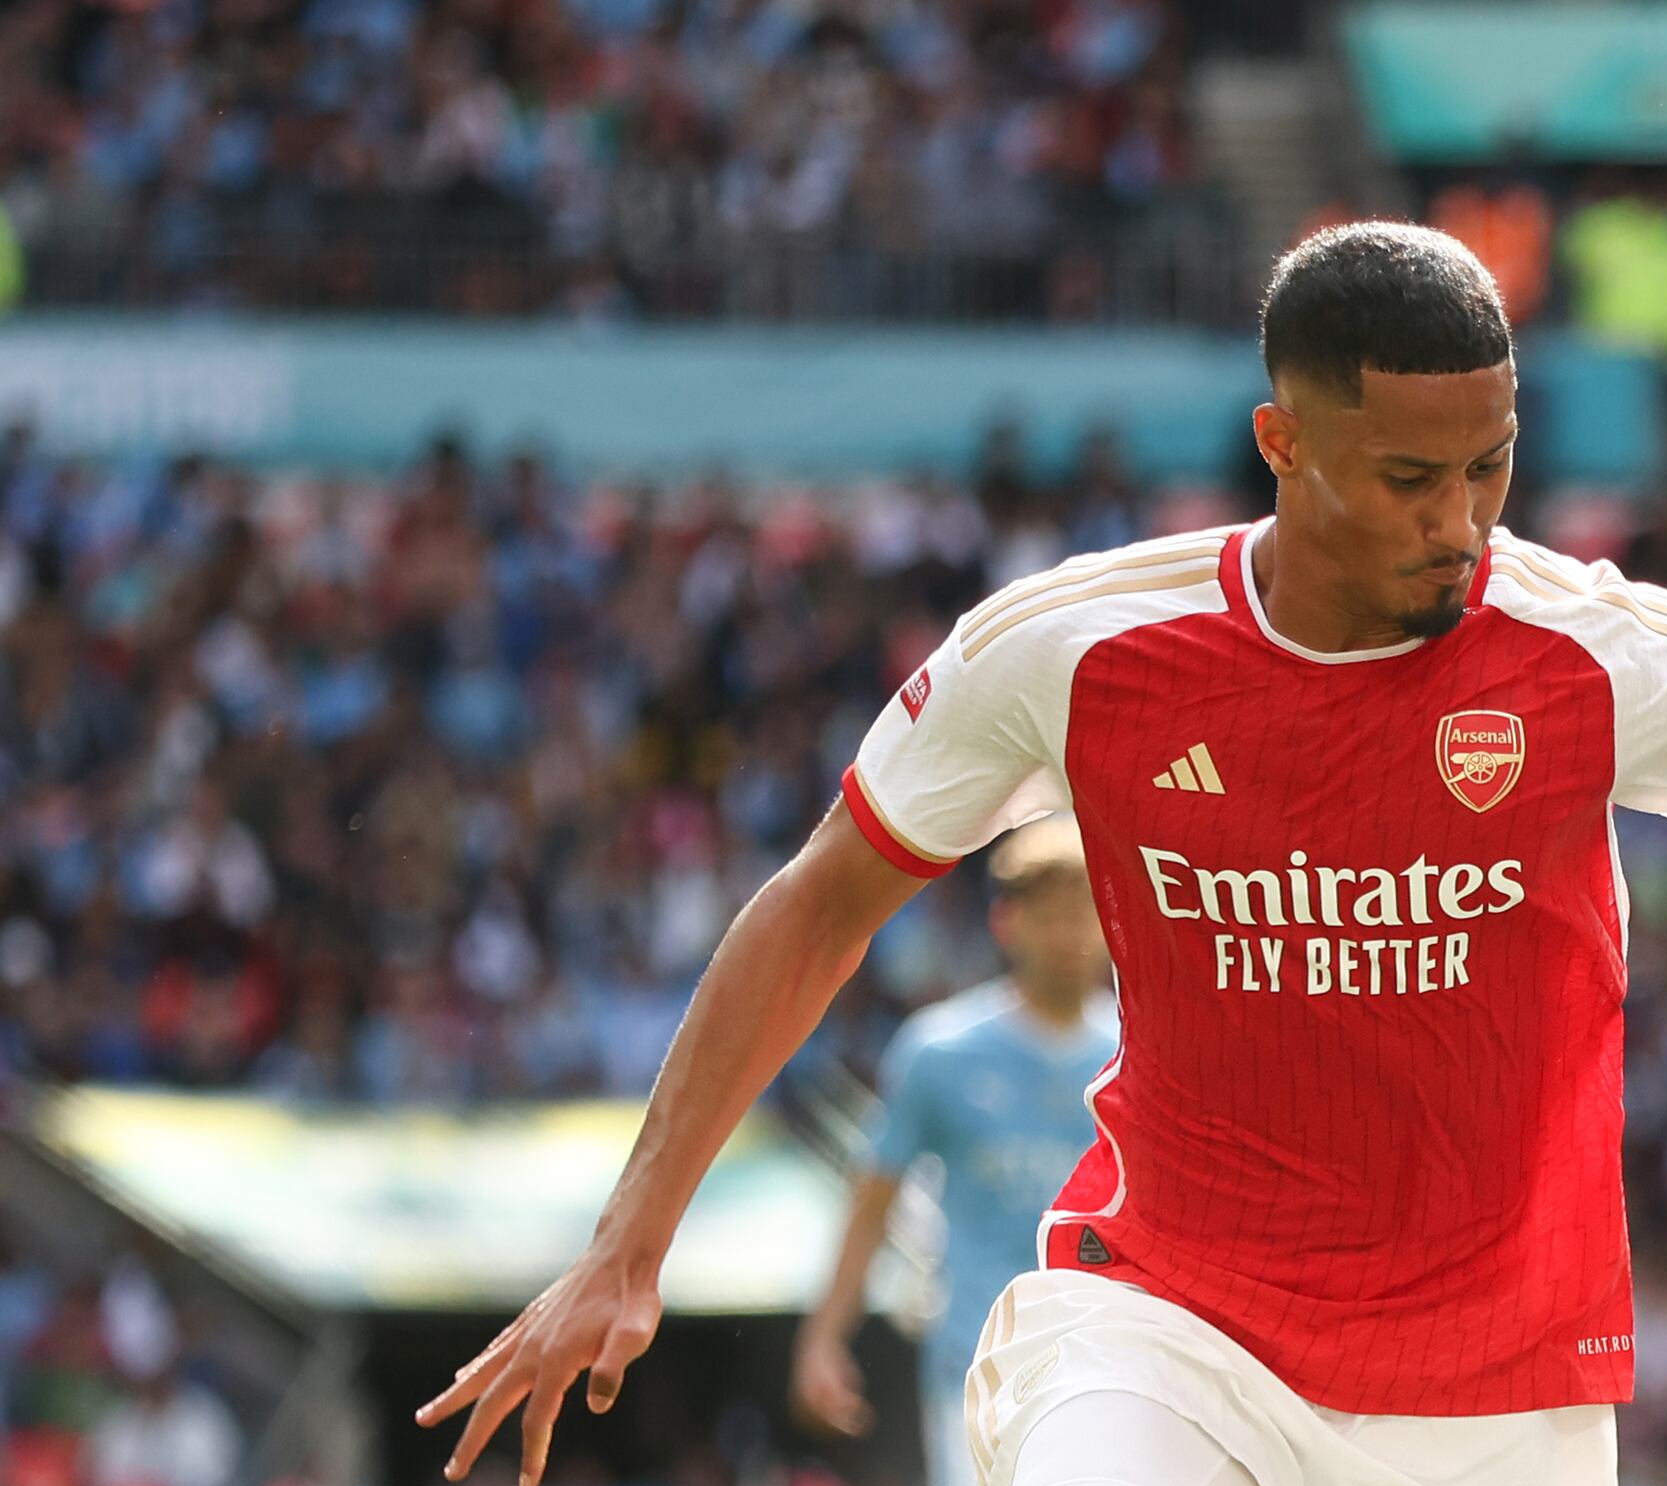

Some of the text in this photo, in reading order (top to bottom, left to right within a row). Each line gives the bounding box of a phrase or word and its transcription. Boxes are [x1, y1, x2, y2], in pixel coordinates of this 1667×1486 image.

[1449, 728, 1512, 744] Arsenal
[1138, 845, 1525, 927] Emirates
[1214, 932, 1470, 996] FLY BETTER
